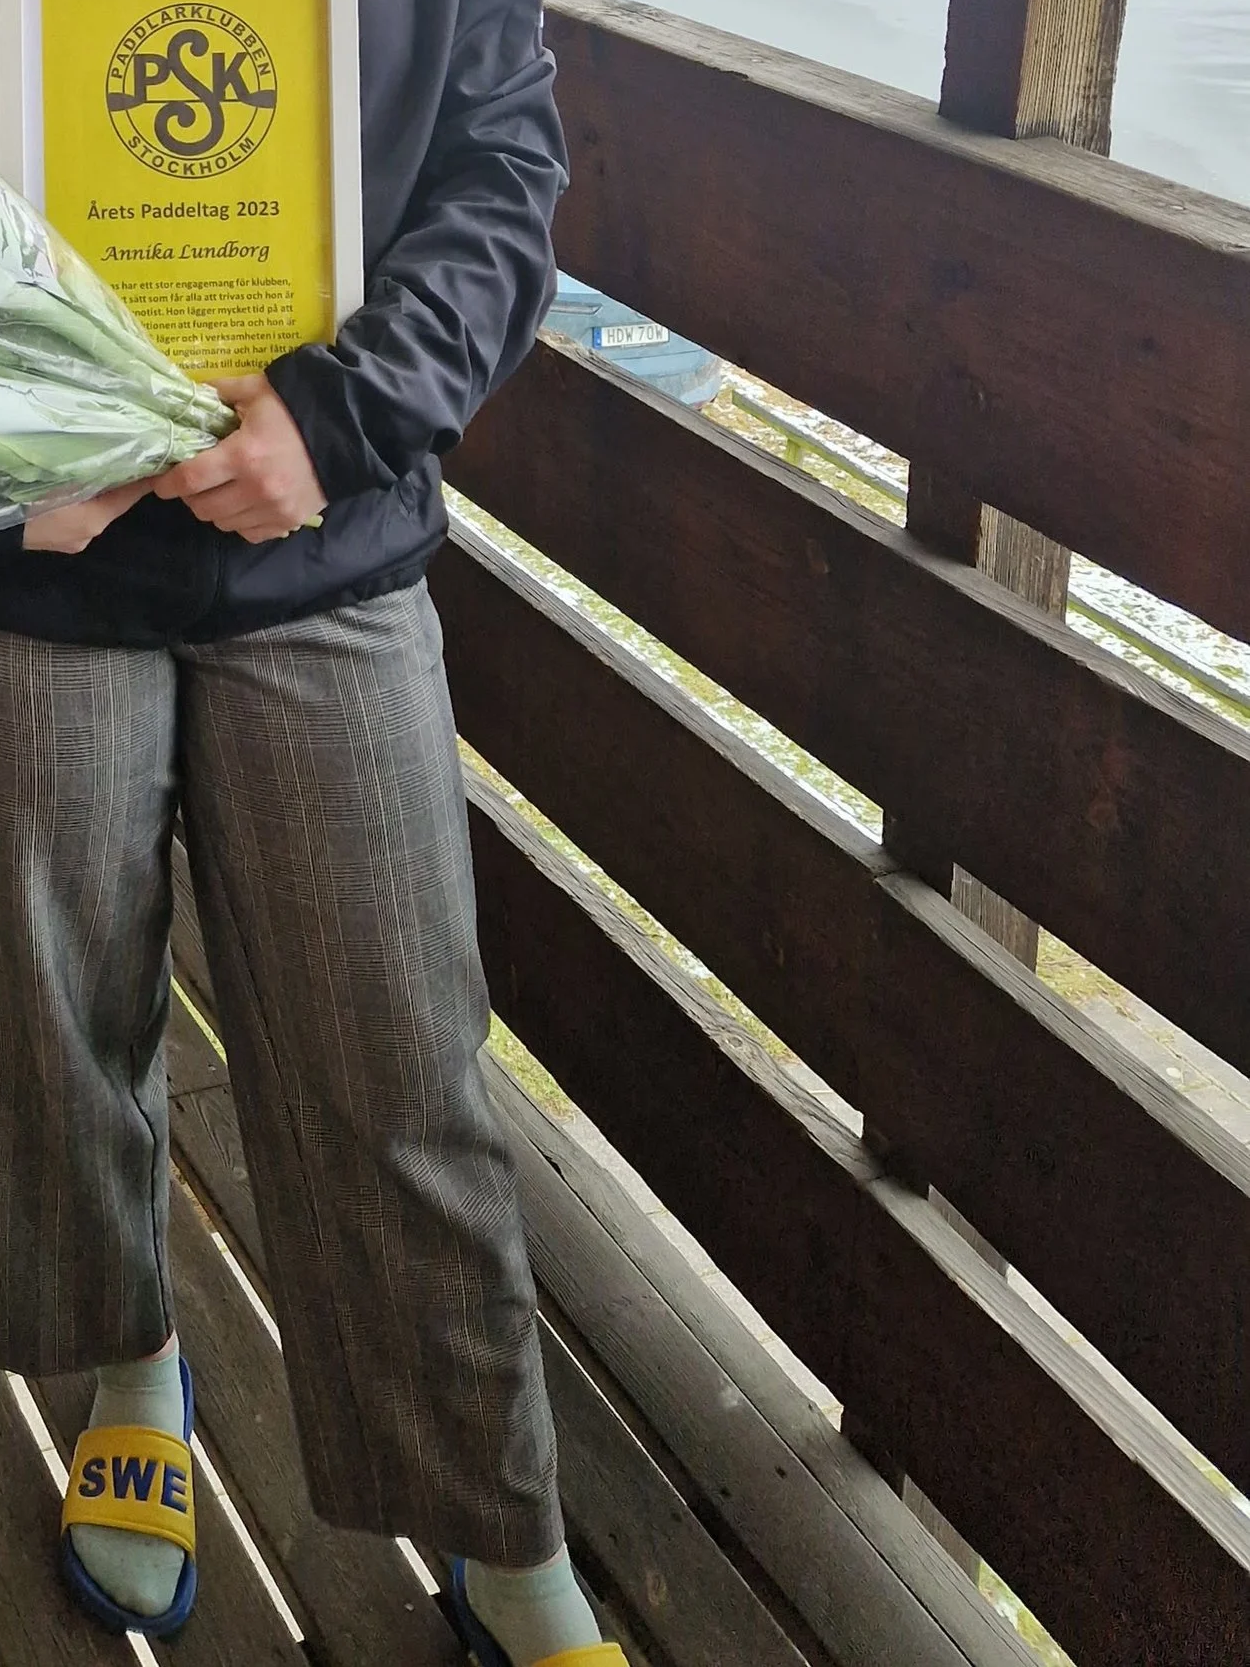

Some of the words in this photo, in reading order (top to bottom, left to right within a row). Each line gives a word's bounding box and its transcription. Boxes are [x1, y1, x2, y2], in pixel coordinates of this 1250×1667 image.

[111, 6, 271, 80] PADDLARKLUBBEN
[132, 29, 250, 156] PSK
[128, 135, 256, 176] STOCKHOLM
[87, 200, 135, 220] Årets
[141, 202, 230, 221] Paddeltag
[236, 200, 280, 217] 2023
[101, 242, 175, 262] Annika
[178, 240, 270, 263] Lundborg
[121, 280, 137, 289] har
[139, 281, 153, 290] ett
[154, 280, 174, 289] stor
[175, 279, 234, 290] engagemang
[236, 278, 250, 287] för
[251, 277, 291, 287] klubben,
[148, 295, 168, 303] som
[170, 293, 183, 302] får
[186, 293, 202, 302] alla
[204, 293, 217, 301] att
[219, 292, 245, 301] trivas
[246, 291, 263, 300] och
[265, 290, 283, 299] hon
[132, 307, 164, 317] notist.
[166, 306, 185, 315] Hon
[187, 306, 216, 317] lägger
[218, 305, 250, 316] mycket
[252, 305, 265, 313] tid
[267, 303, 278, 314] på
[281, 304, 293, 313] att
[178, 321, 191, 330] att
[193, 319, 228, 330] fungera
[230, 318, 245, 327] bra
[247, 318, 264, 327] och
[266, 317, 284, 327] hon
[156, 334, 179, 344] läger
[181, 334, 198, 343] och
[205, 332, 272, 342] verksamheten
[607, 327, 634, 344] HDW
[638, 324, 664, 342] 70W
[234, 345, 250, 354] och
[252, 345, 268, 354] har
[270, 343, 287, 353] fått
[220, 359, 233, 368] till
[235, 358, 269, 369] duktiga
[78, 1456, 188, 1515] SWE
